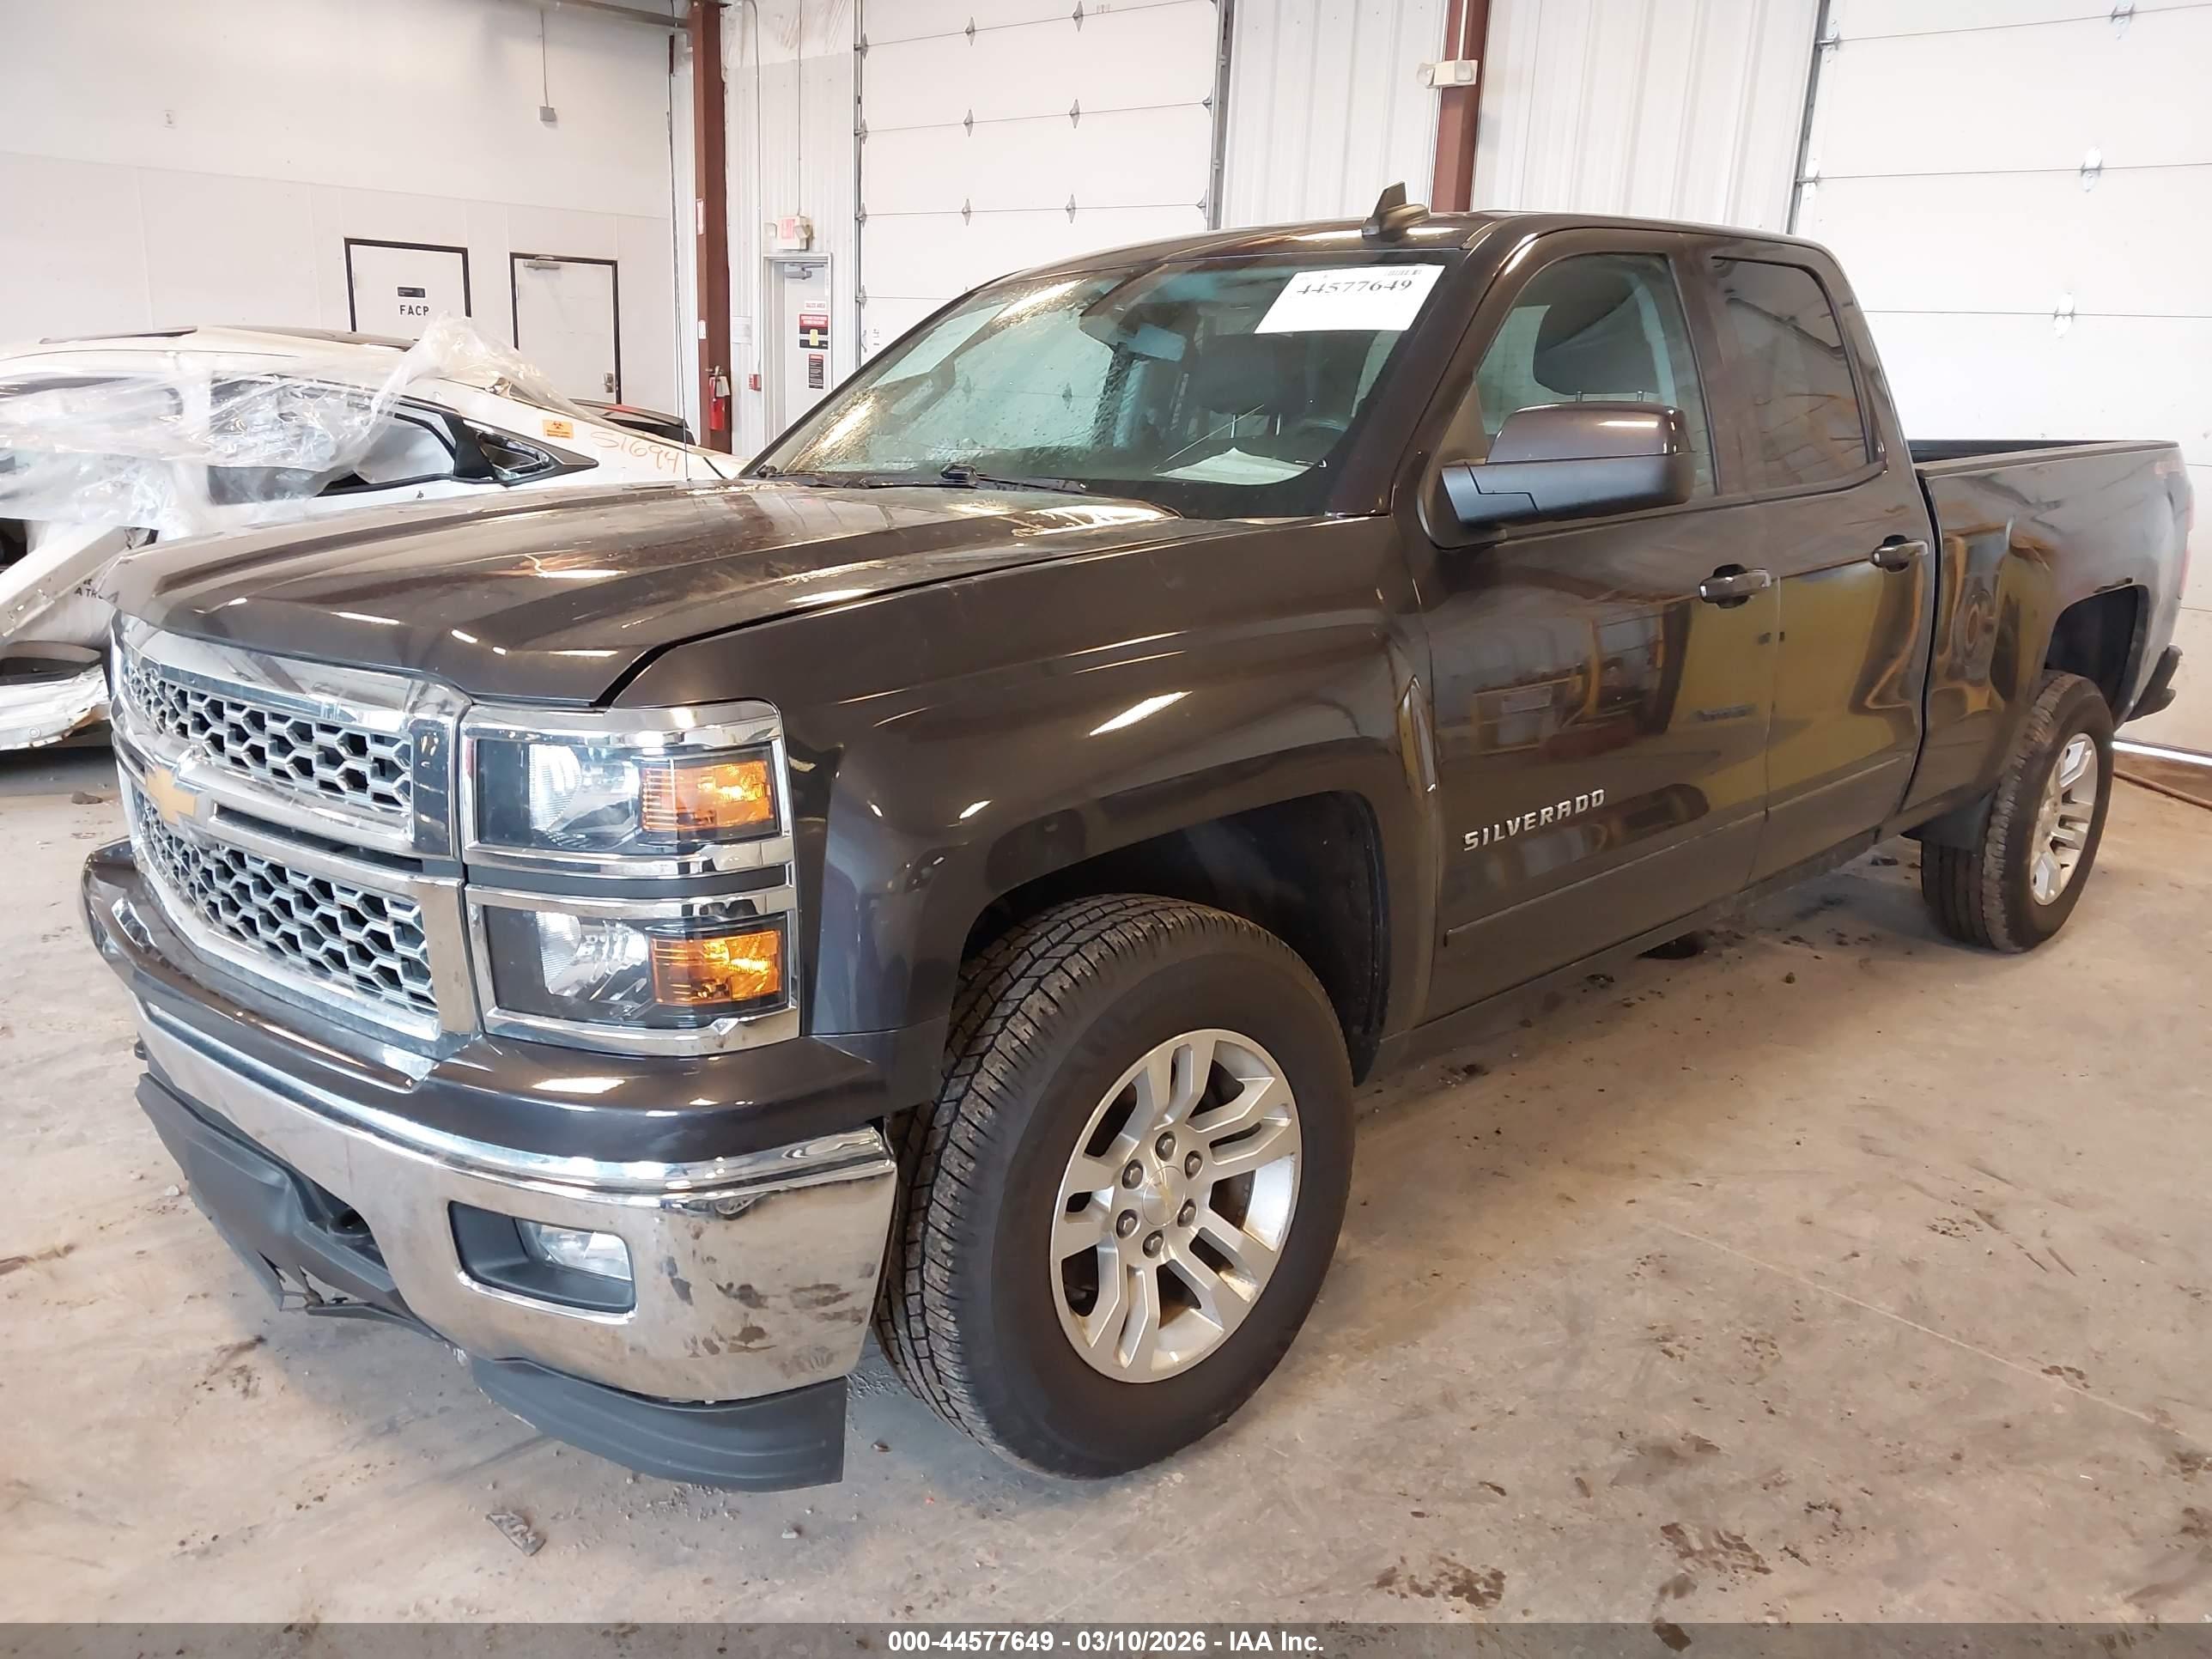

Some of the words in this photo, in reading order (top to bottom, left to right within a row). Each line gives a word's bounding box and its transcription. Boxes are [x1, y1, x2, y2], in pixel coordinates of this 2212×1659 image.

[1297, 278, 1413, 295] 44577649
[399, 304, 429, 317] FACP
[1463, 787, 1606, 852] SILVERADO
